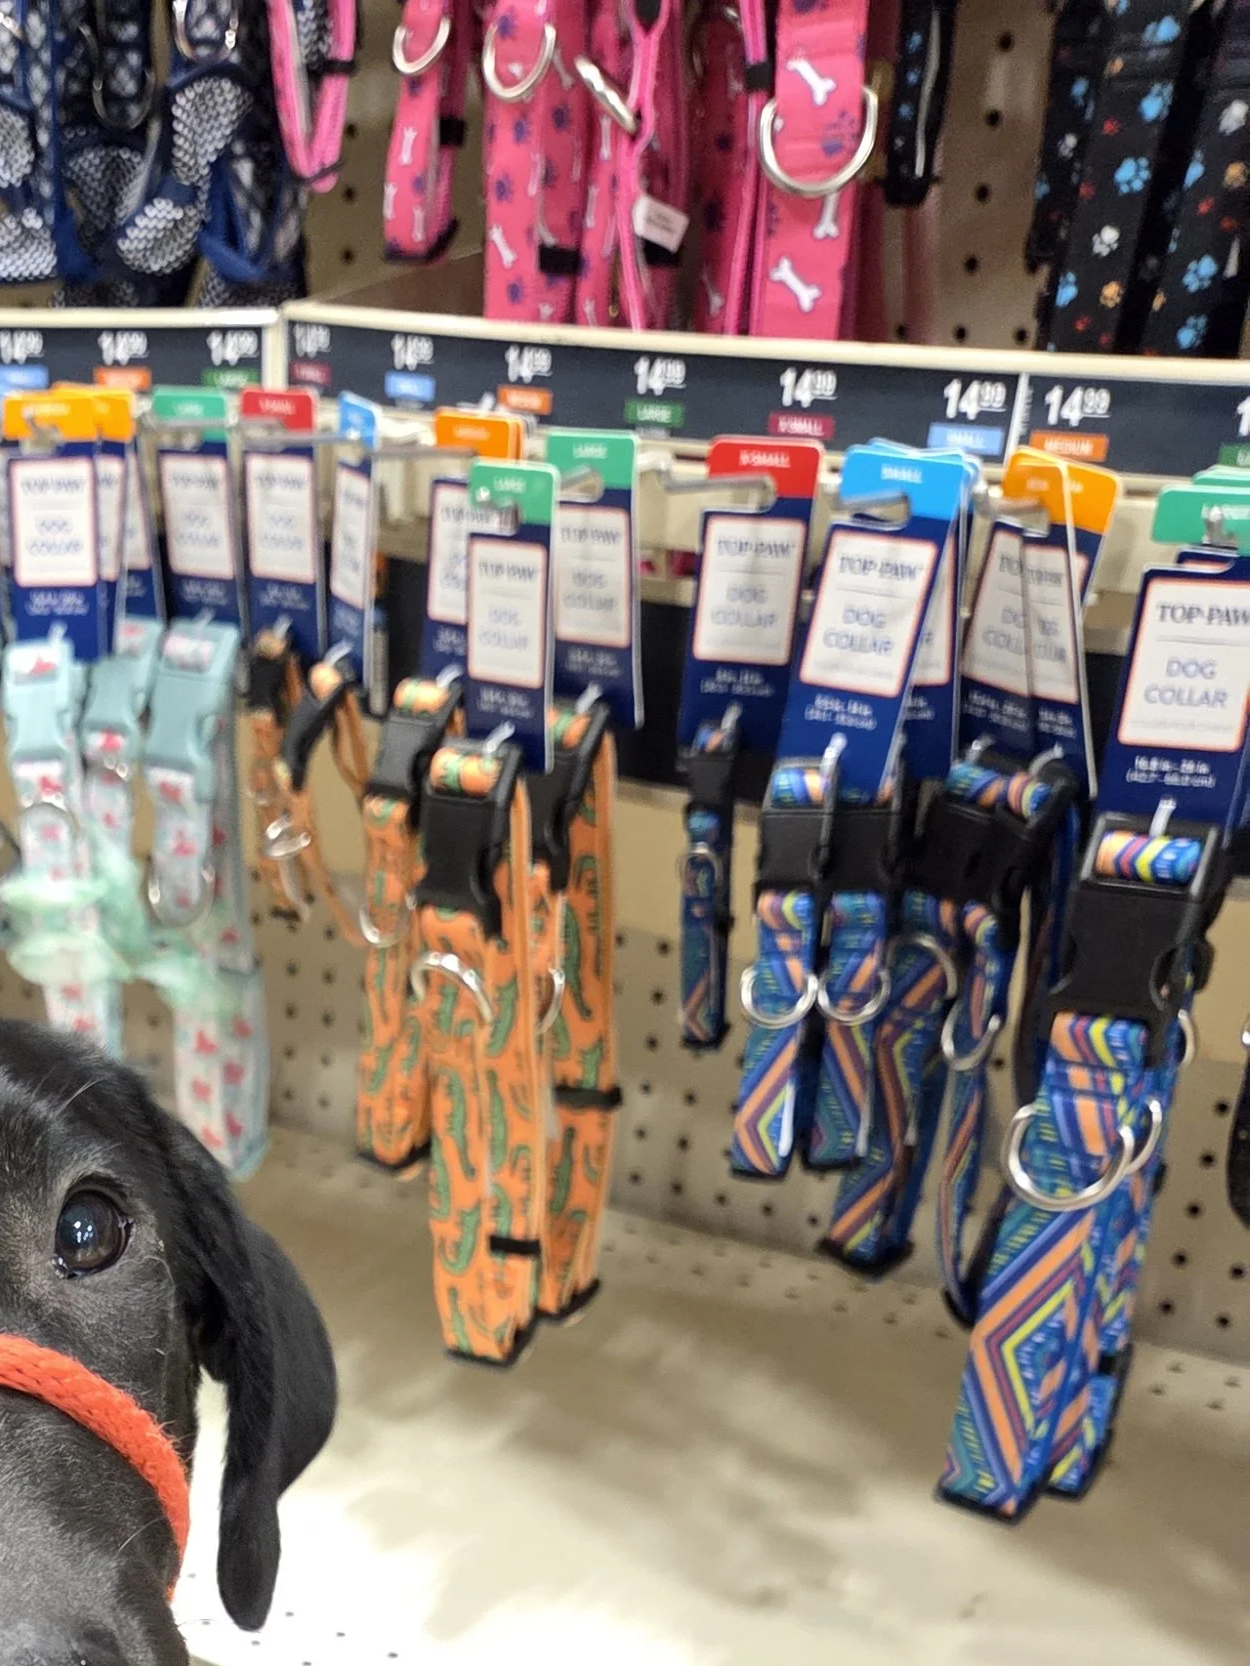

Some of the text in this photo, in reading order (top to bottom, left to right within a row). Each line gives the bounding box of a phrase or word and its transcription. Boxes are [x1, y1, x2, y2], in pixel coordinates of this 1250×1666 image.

[840, 554, 918, 582] TOP PAW
[843, 605, 887, 629] DOG
[1158, 602, 1250, 627] TOP PAW
[823, 628, 893, 656] COLLAR
[1166, 656, 1217, 680] DOG
[1143, 683, 1229, 709] COLLAR
